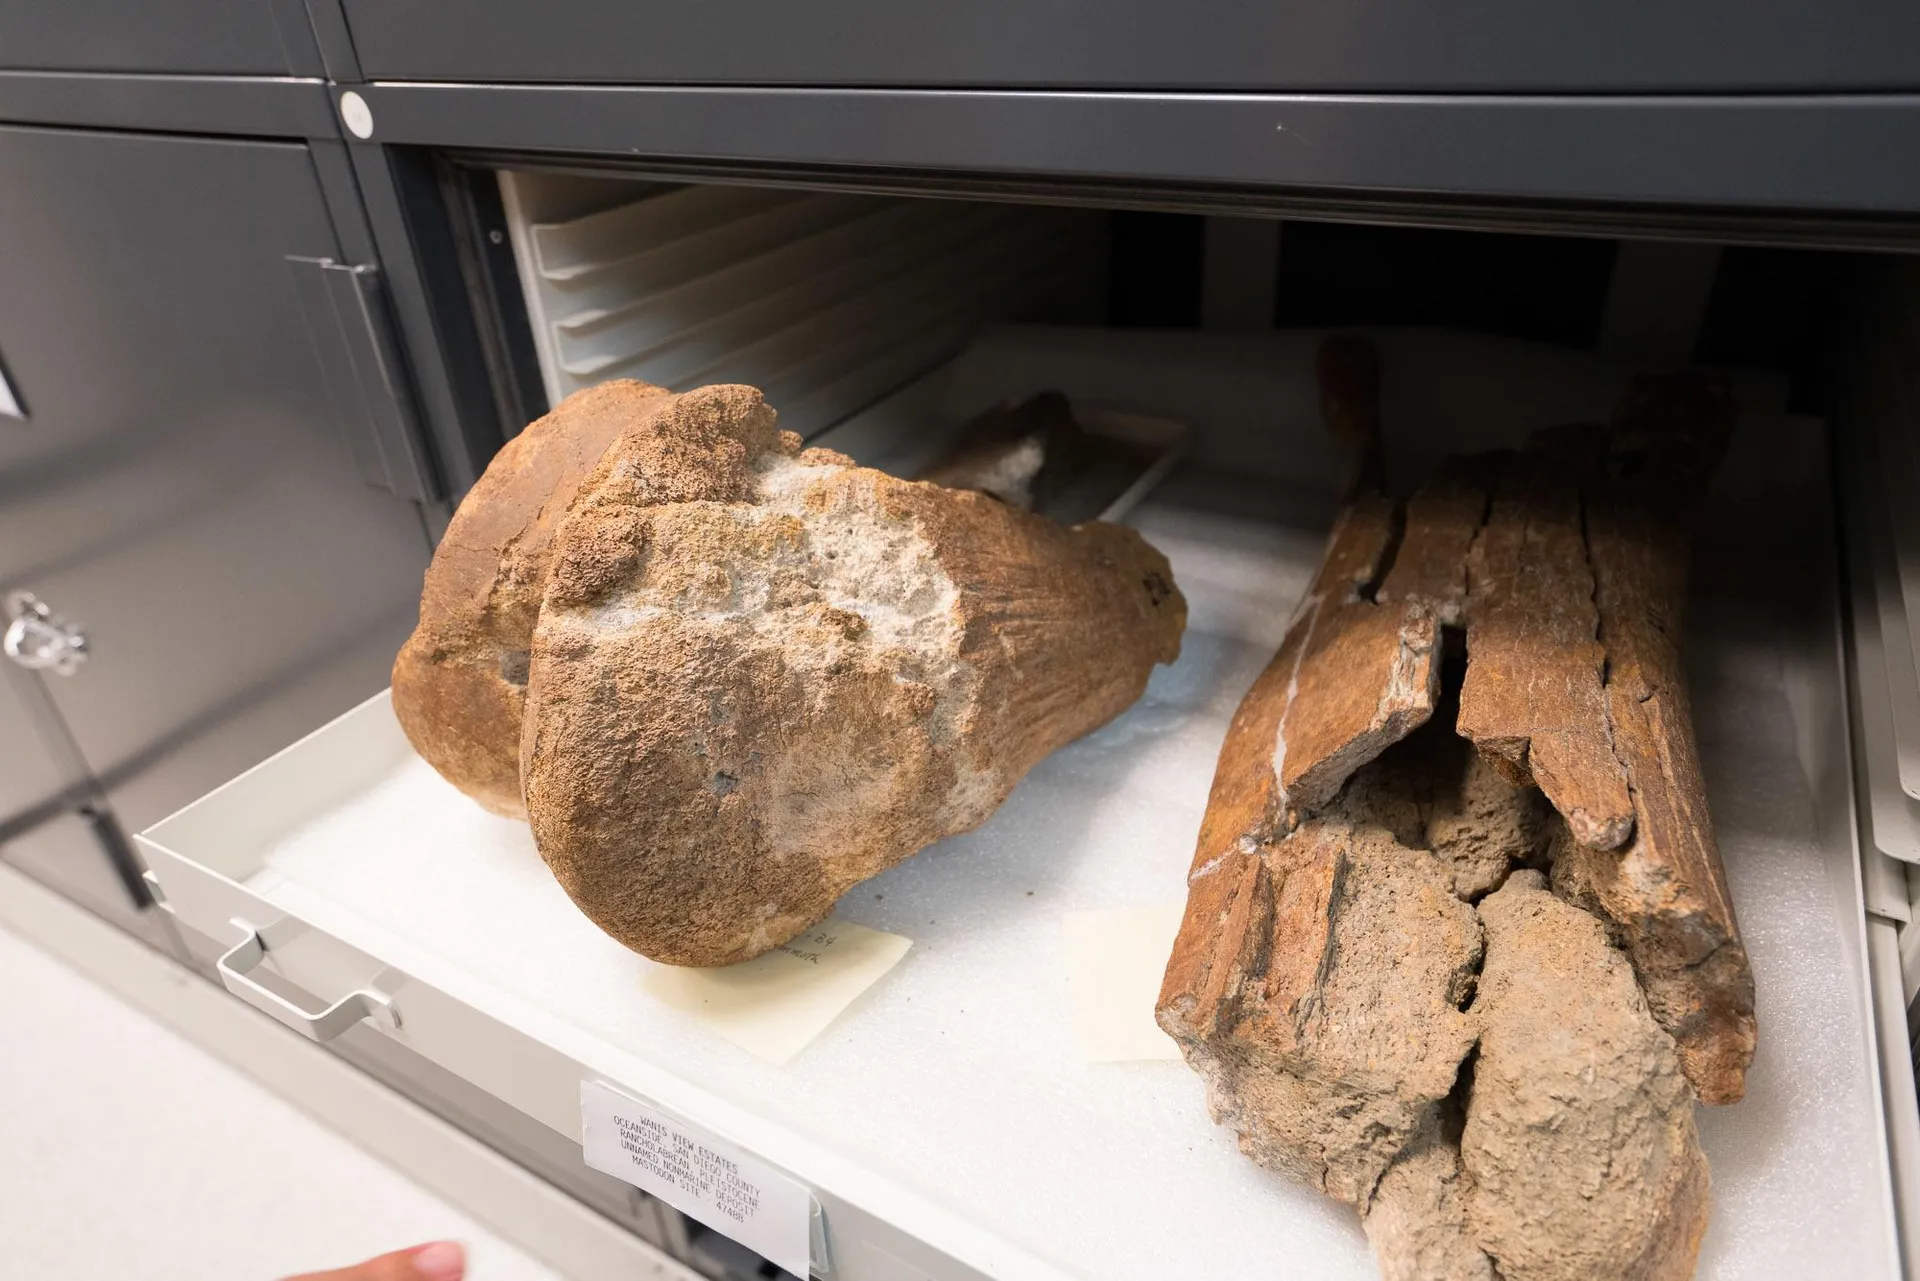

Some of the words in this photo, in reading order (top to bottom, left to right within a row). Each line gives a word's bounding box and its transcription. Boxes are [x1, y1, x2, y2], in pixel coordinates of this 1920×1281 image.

[672, 1132, 694, 1151] VIEW
[699, 1146, 737, 1174] ESTATES
[673, 1143, 689, 1160] SAN
[693, 1155, 721, 1177] DIEGO
[726, 1173, 760, 1197] COUNTY
[621, 1139, 658, 1164] UNNAMED
[663, 1160, 711, 1193] NONMARINE
[716, 1189, 754, 1217] DEPOSIT
[632, 1155, 675, 1183] MASTODON
[680, 1178, 700, 1198] SITE
[700, 1169, 760, 1210] PLEISTOCENE
